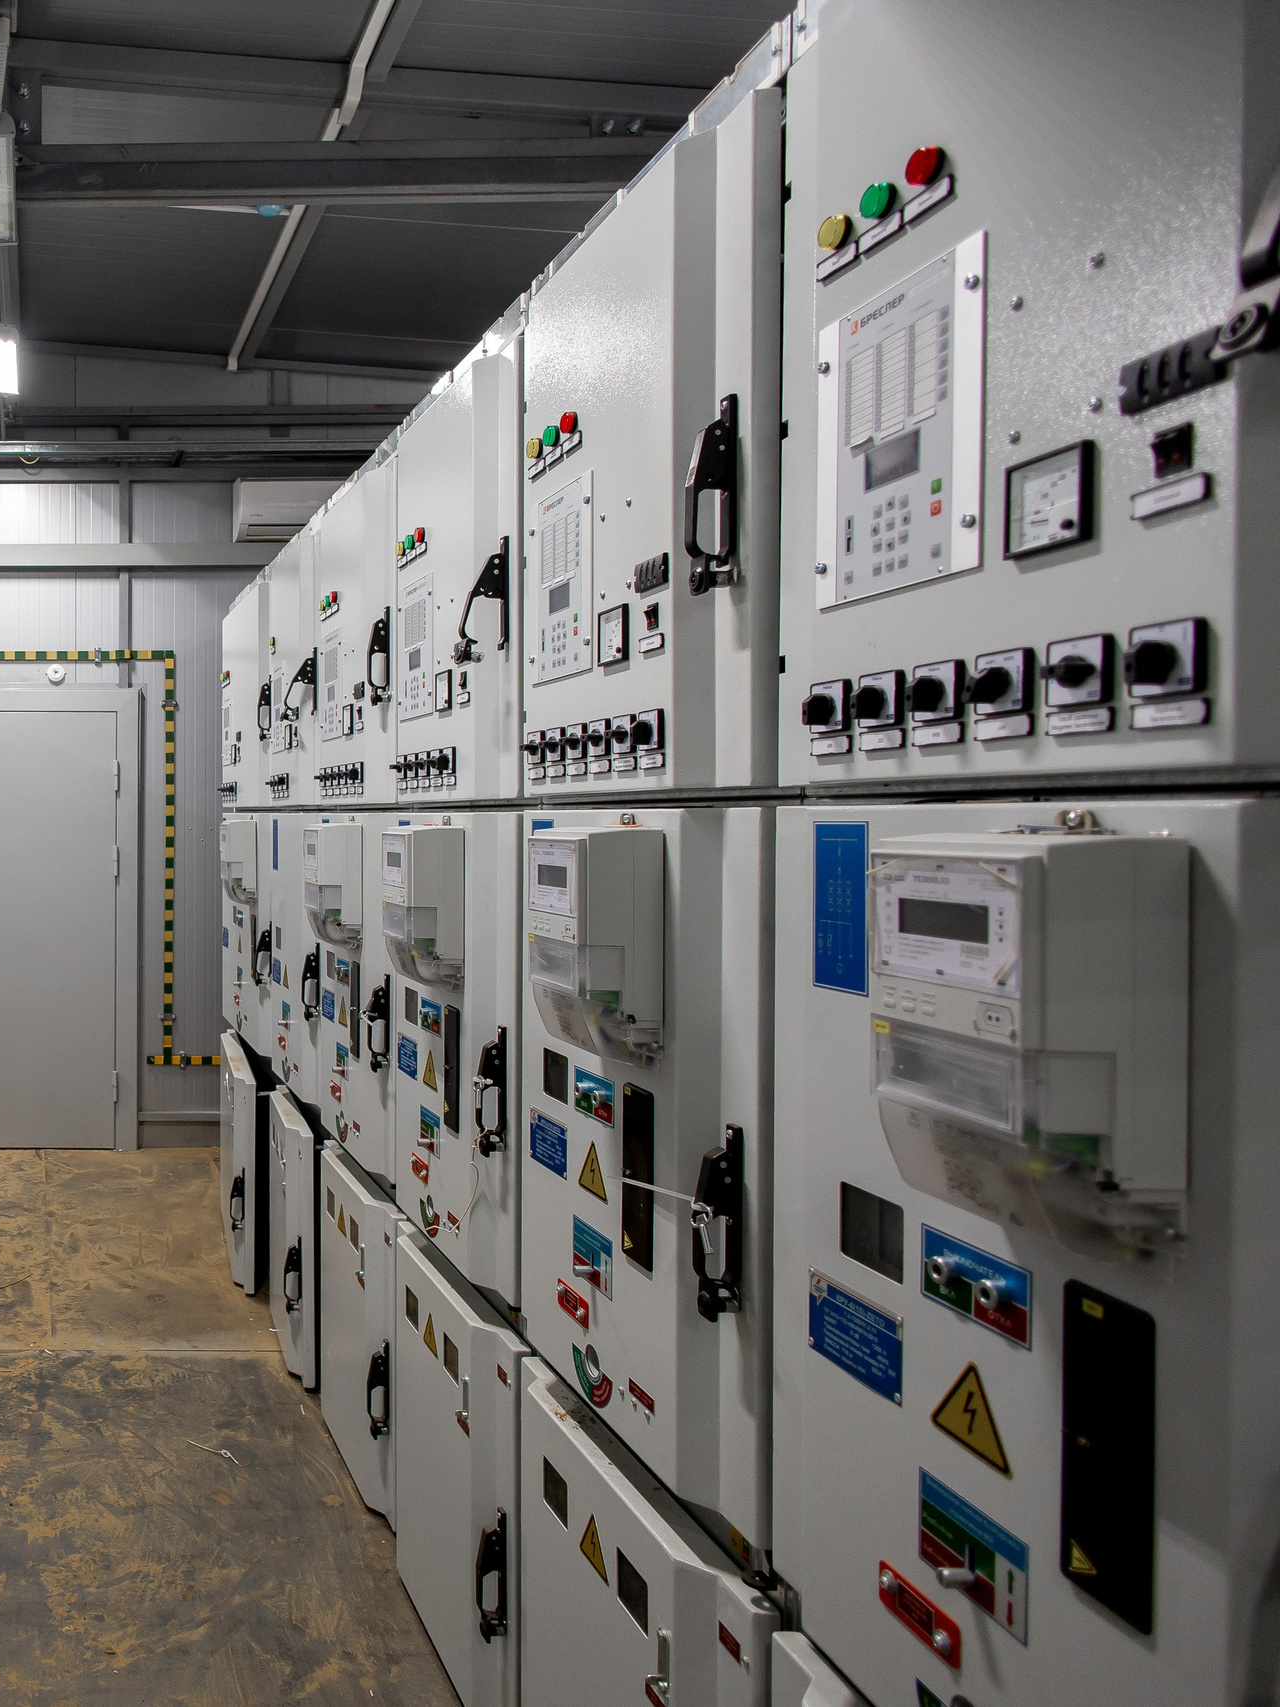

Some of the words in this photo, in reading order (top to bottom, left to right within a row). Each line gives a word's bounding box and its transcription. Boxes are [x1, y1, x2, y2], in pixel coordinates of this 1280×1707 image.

[860, 293, 905, 329] БРЕСЛЕР
[939, 1285, 956, 1300] ВКЛ
[987, 1310, 1012, 1329] ОТКЛ
